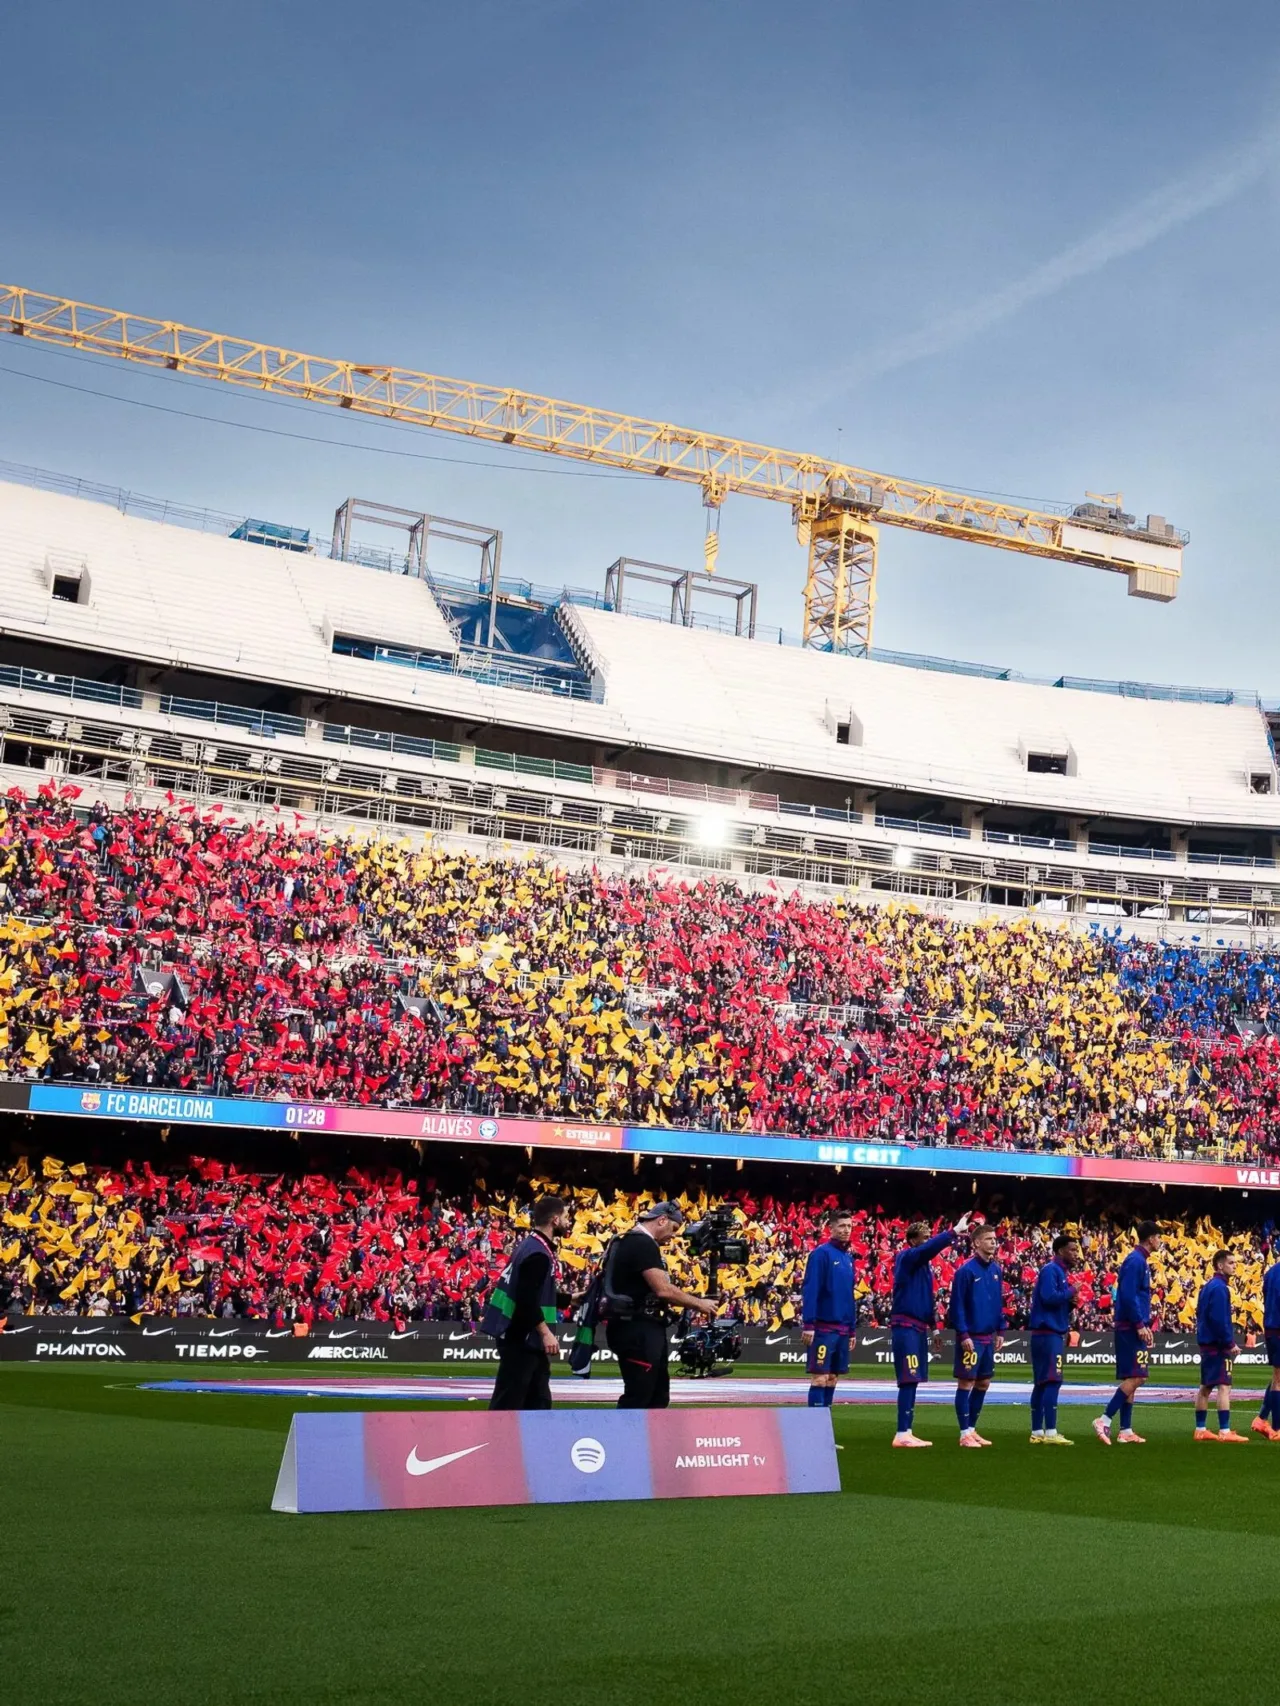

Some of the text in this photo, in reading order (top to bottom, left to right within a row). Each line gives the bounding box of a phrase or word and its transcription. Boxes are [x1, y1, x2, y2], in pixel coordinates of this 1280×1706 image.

[106, 1094, 214, 1119] FC BARCELONA
[286, 1107, 326, 1126] 01:28
[421, 1116, 473, 1136] ALAVÉS
[566, 1130, 611, 1141] ESTRELLA
[853, 1147, 902, 1164] CRIT
[35, 1342, 127, 1356] PHANTOM
[174, 1344, 258, 1358] TIEMPO
[307, 1346, 389, 1359] MERCURIAL
[443, 1347, 501, 1359] PHANTO
[817, 1345, 827, 1360] 9
[906, 1355, 919, 1369] 10
[962, 1351, 978, 1365] 20
[993, 1352, 1027, 1364] CURIAL
[1056, 1355, 1063, 1368] 3
[1136, 1350, 1149, 1364] 22
[1150, 1353, 1202, 1364] TIEMPO
[695, 1437, 742, 1448] PHILIPS
[675, 1454, 766, 1468] AMBILIGHT tv
